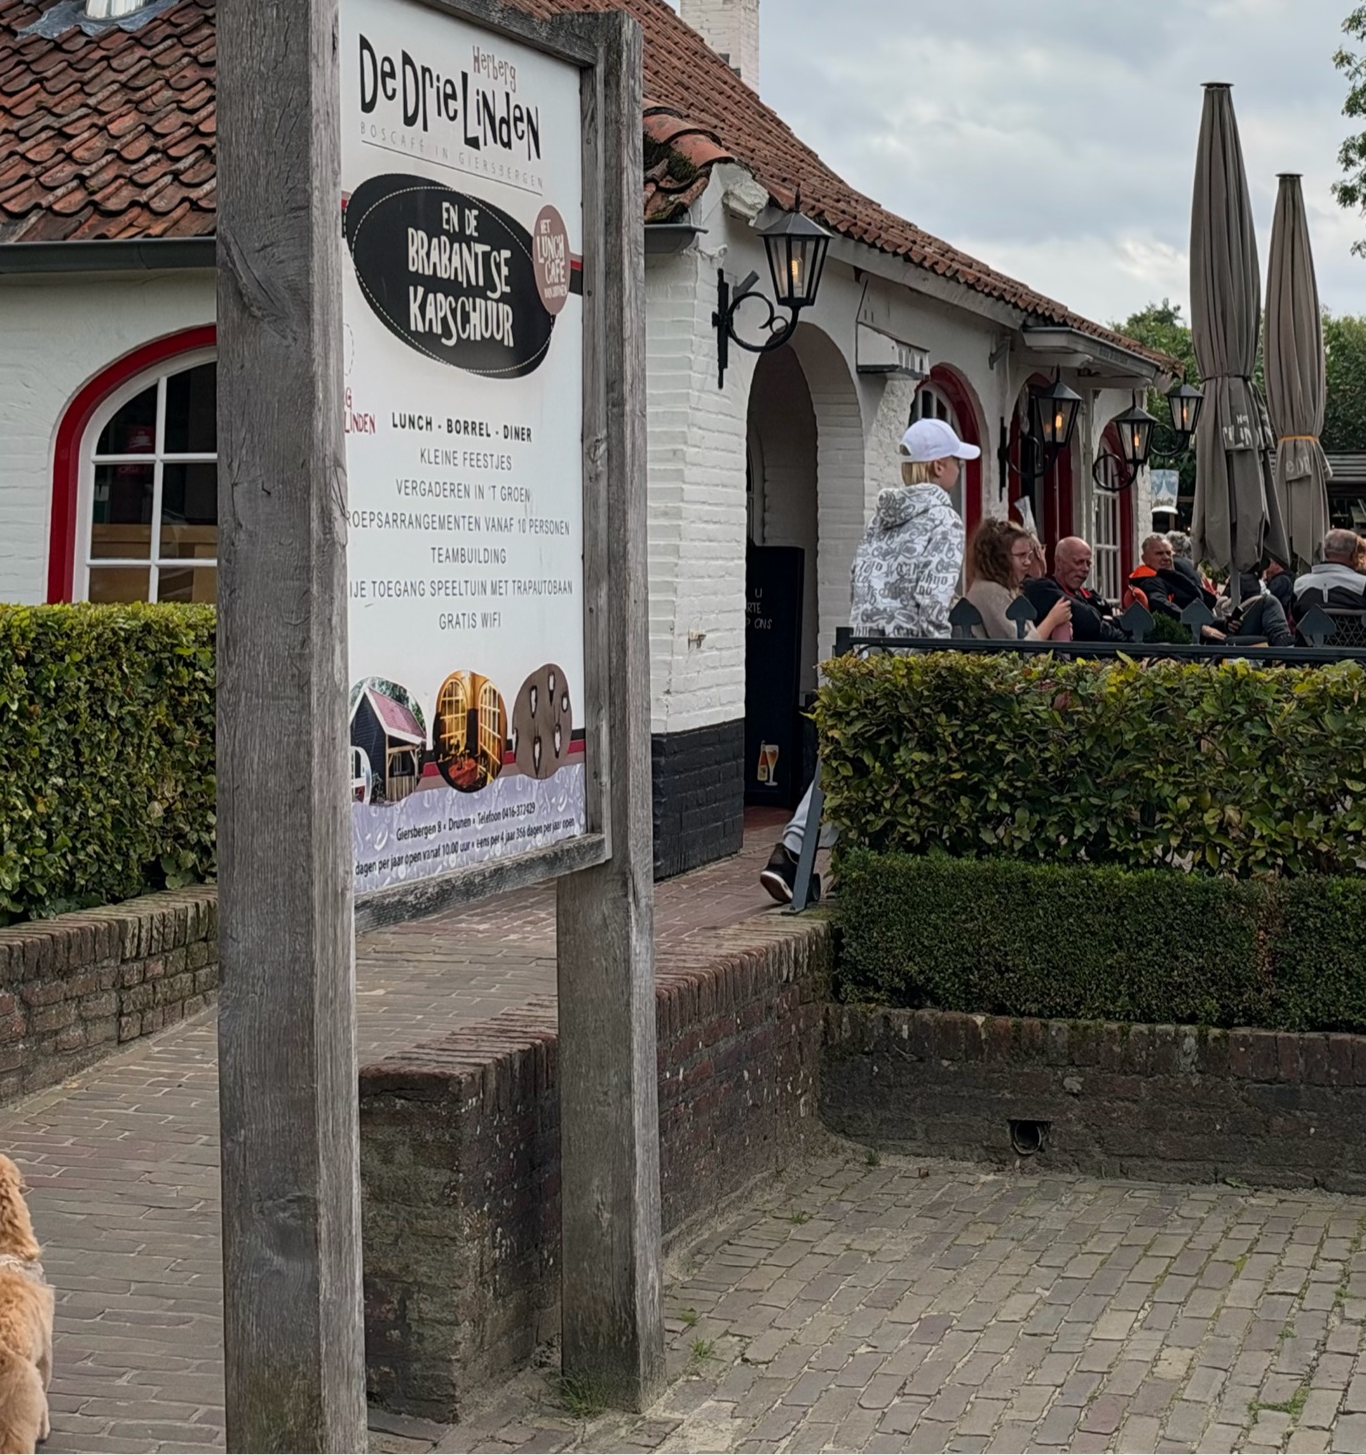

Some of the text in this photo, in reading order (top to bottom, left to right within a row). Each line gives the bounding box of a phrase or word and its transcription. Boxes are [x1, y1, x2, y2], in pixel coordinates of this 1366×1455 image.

[359, 33, 397, 114] De
[401, 49, 459, 132] Drie
[472, 45, 516, 93] Herberg
[435, 145, 449, 160] IN
[458, 151, 543, 189] GIERSBERGEN
[441, 201, 479, 237] EN DE
[536, 233, 565, 264] LUNCH
[408, 285, 515, 348] KAPSCHUUR
[344, 411, 376, 435] LINDEN
[391, 411, 533, 443] LUNCH BORREL DINER
[420, 447, 512, 472] KLEINE FEESTJES
[395, 477, 471, 500] VERGADEREN
[474, 483, 485, 501] IN
[500, 485, 531, 503] GROEN
[346, 510, 570, 536] ROEPSARRANGEMENTEN VANAF 10 PERSONEN
[430, 546, 507, 564] TEAMBUILDING
[349, 579, 573, 598] IJE TOEGANG SPEELTUIN MET TRAPAUTOBAAN
[438, 611, 501, 630] GRATIS WIFI
[746, 601, 761, 614] RTE
[396, 824, 437, 842] Giersbergen
[448, 817, 472, 831] Drunen
[477, 809, 502, 825] Telefoon
[355, 860, 376, 877] dagen
[378, 858, 390, 874] per
[390, 853, 404, 871] jaar
[404, 851, 422, 867] open
[423, 844, 441, 861] vanaf
[460, 840, 471, 853] uur
[490, 835, 500, 851] per
[505, 829, 515, 846] jaar
[526, 824, 543, 839] dagen
[543, 822, 552, 836] per
[552, 819, 562, 834] jaar
[562, 817, 575, 831] open
